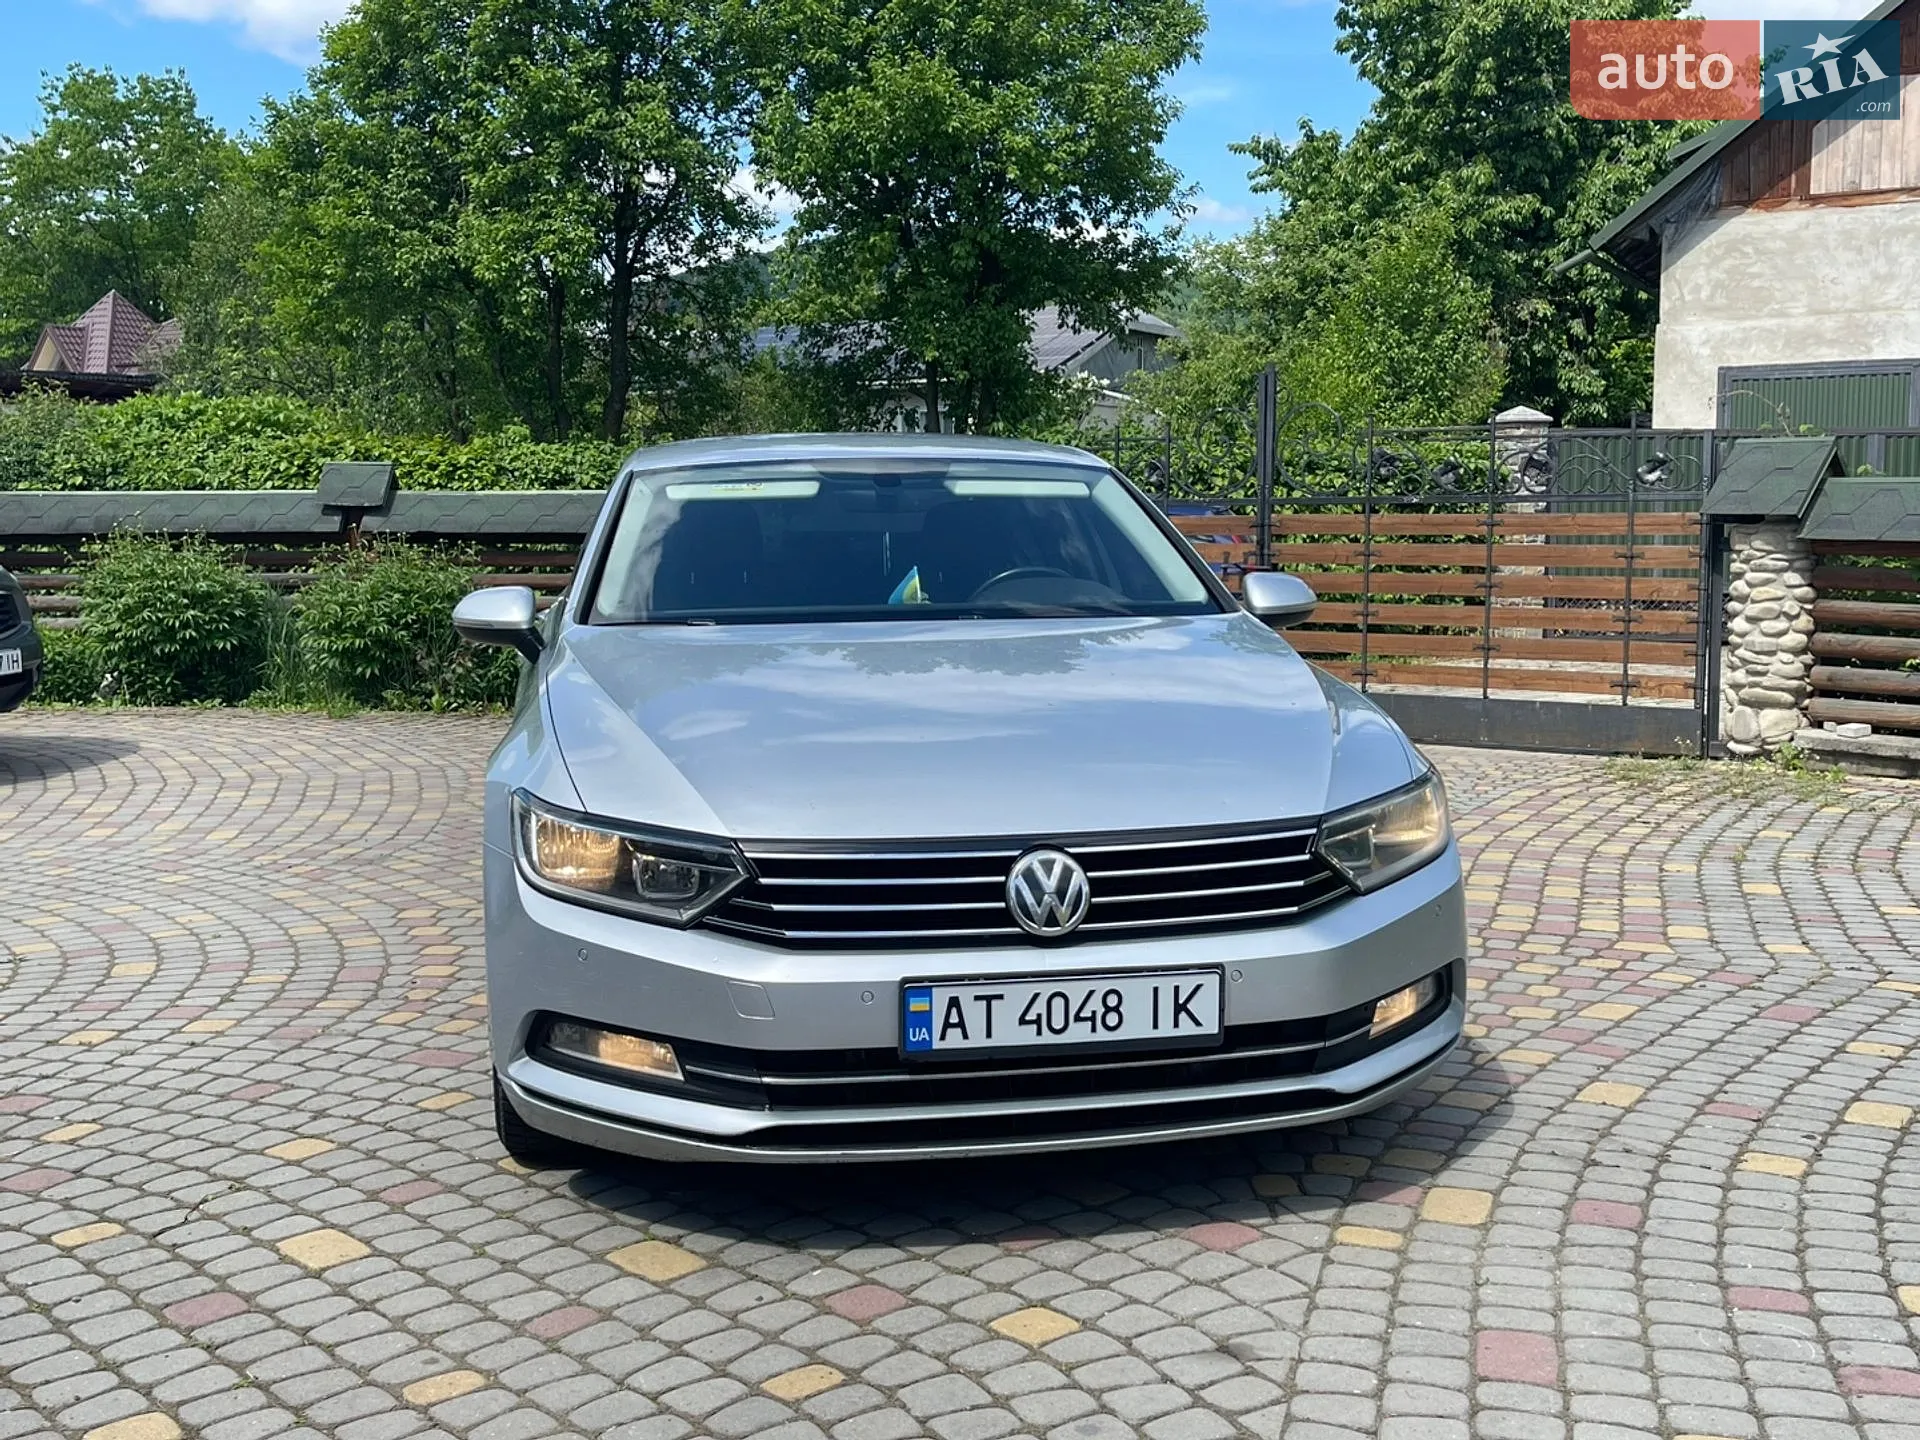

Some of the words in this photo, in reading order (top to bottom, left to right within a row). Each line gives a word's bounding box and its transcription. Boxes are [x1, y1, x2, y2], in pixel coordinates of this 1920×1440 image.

[938, 993, 1004, 1042] AT
[1018, 988, 1124, 1037] 4048
[1151, 983, 1204, 1030] IK
[909, 1027, 929, 1042] UA
